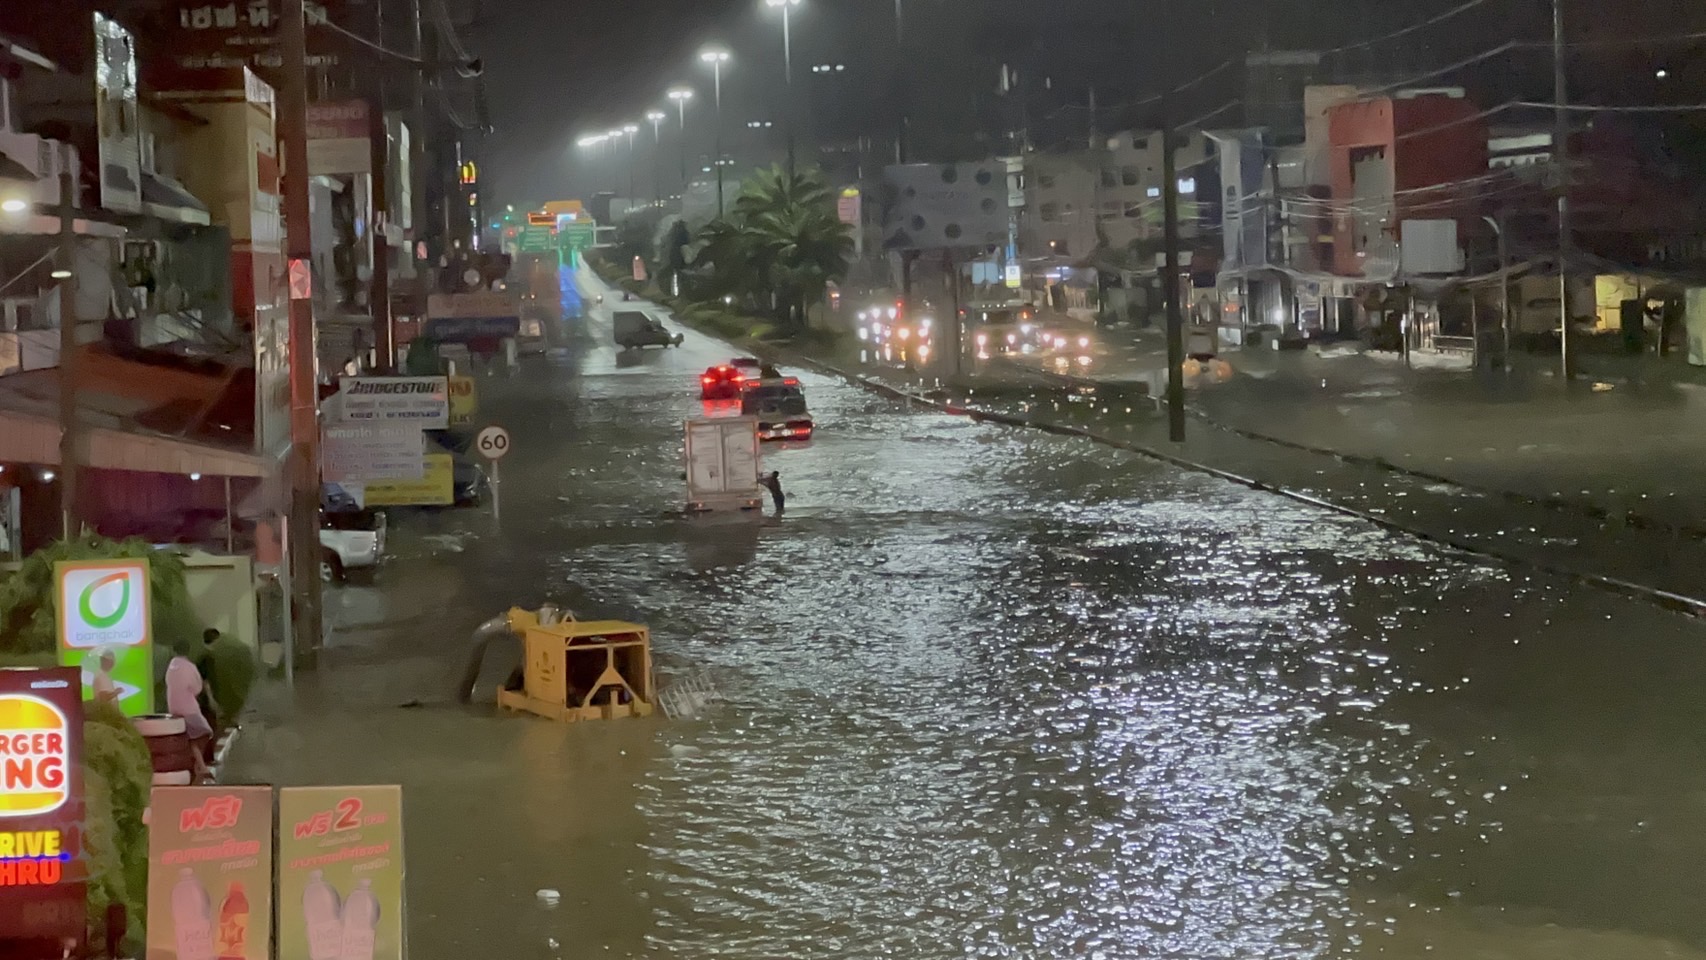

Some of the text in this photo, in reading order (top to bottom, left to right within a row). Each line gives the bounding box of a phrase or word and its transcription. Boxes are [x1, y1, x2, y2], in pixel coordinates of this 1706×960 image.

[347, 381, 445, 394] BRIDGESTONE
[481, 434, 507, 450] 60
[76, 629, 134, 642] bangchak
[180, 795, 243, 832] ฟรี!
[294, 811, 333, 840] ฟรี
[334, 797, 363, 832] 2
[0, 831, 60, 858] RIVE
